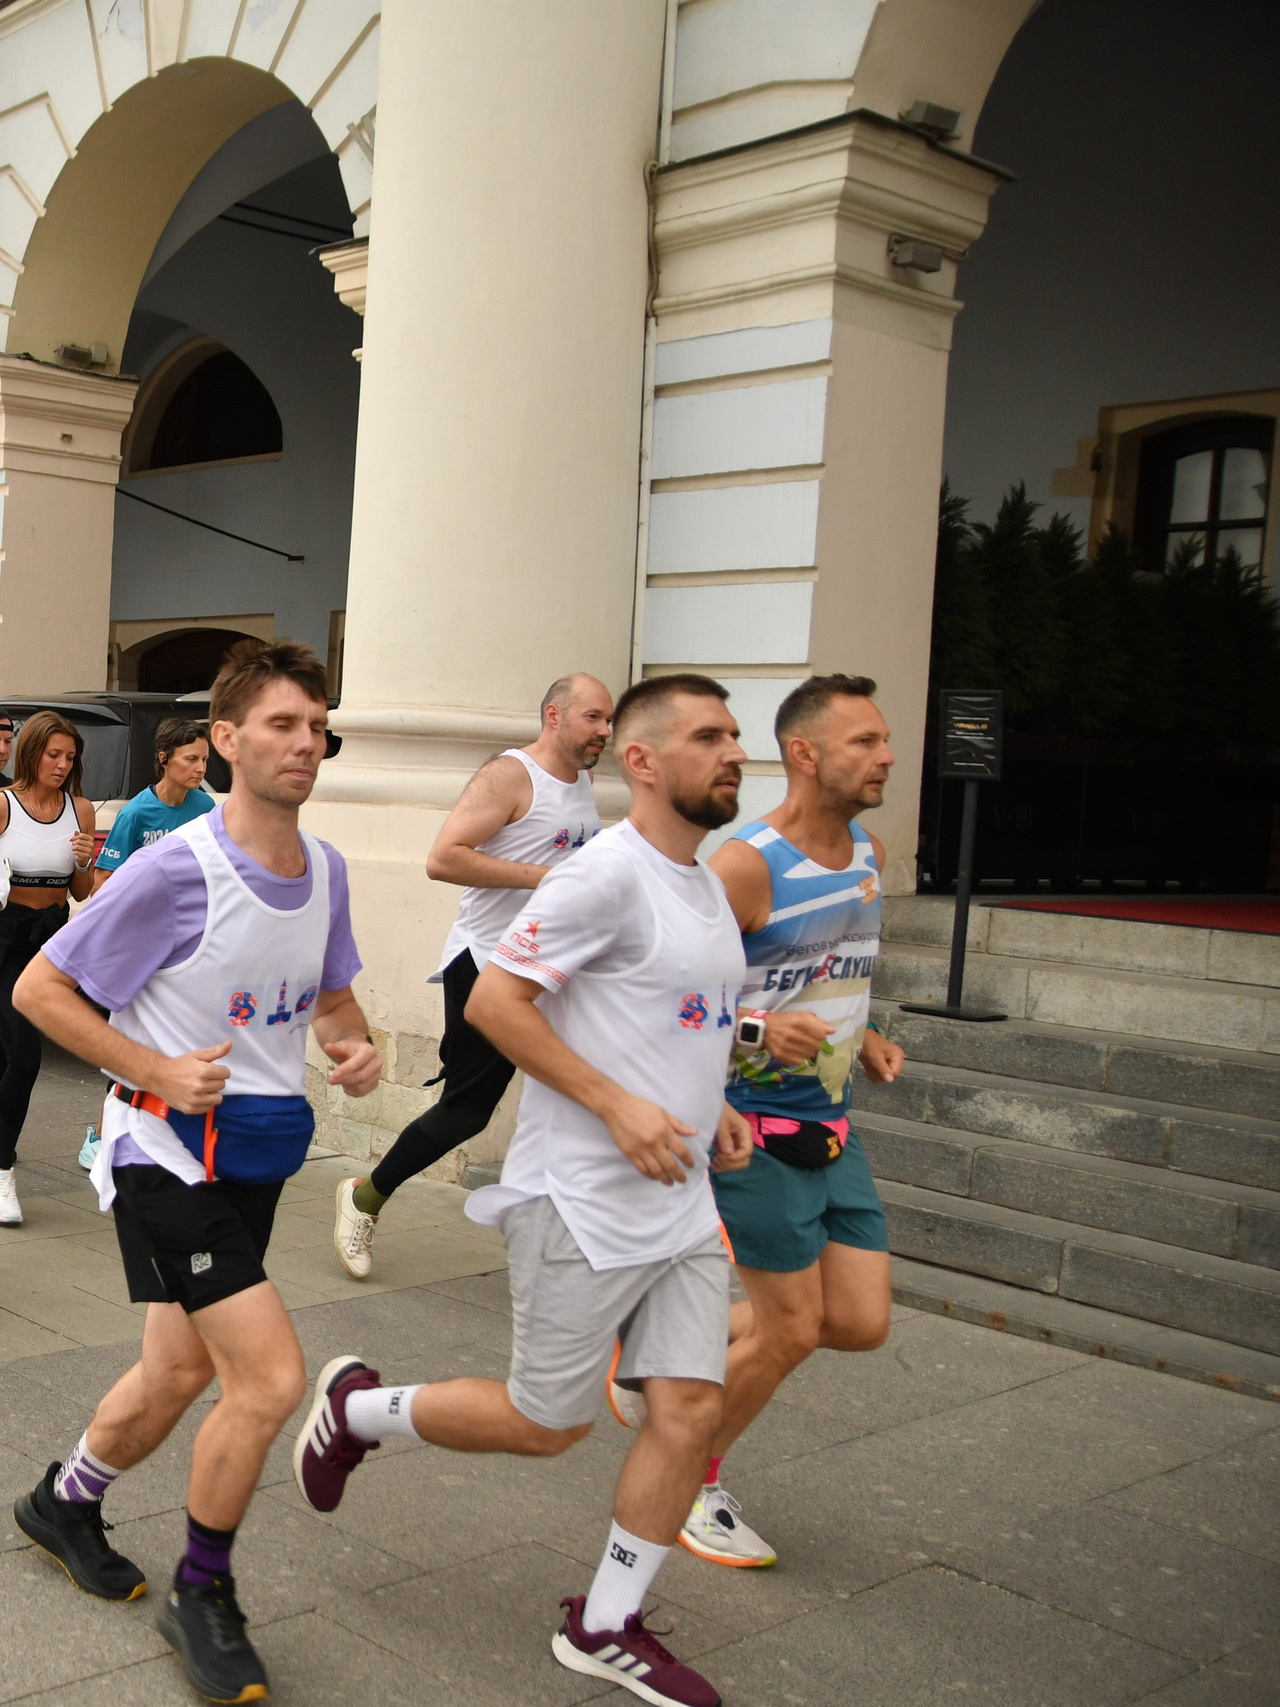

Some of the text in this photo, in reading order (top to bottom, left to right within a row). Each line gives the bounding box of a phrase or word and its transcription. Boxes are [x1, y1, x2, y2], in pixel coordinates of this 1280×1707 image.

[100, 846, 121, 859] ПСБ
[11, 876, 41, 884] EMIX
[509, 932, 541, 954] ПСБ
